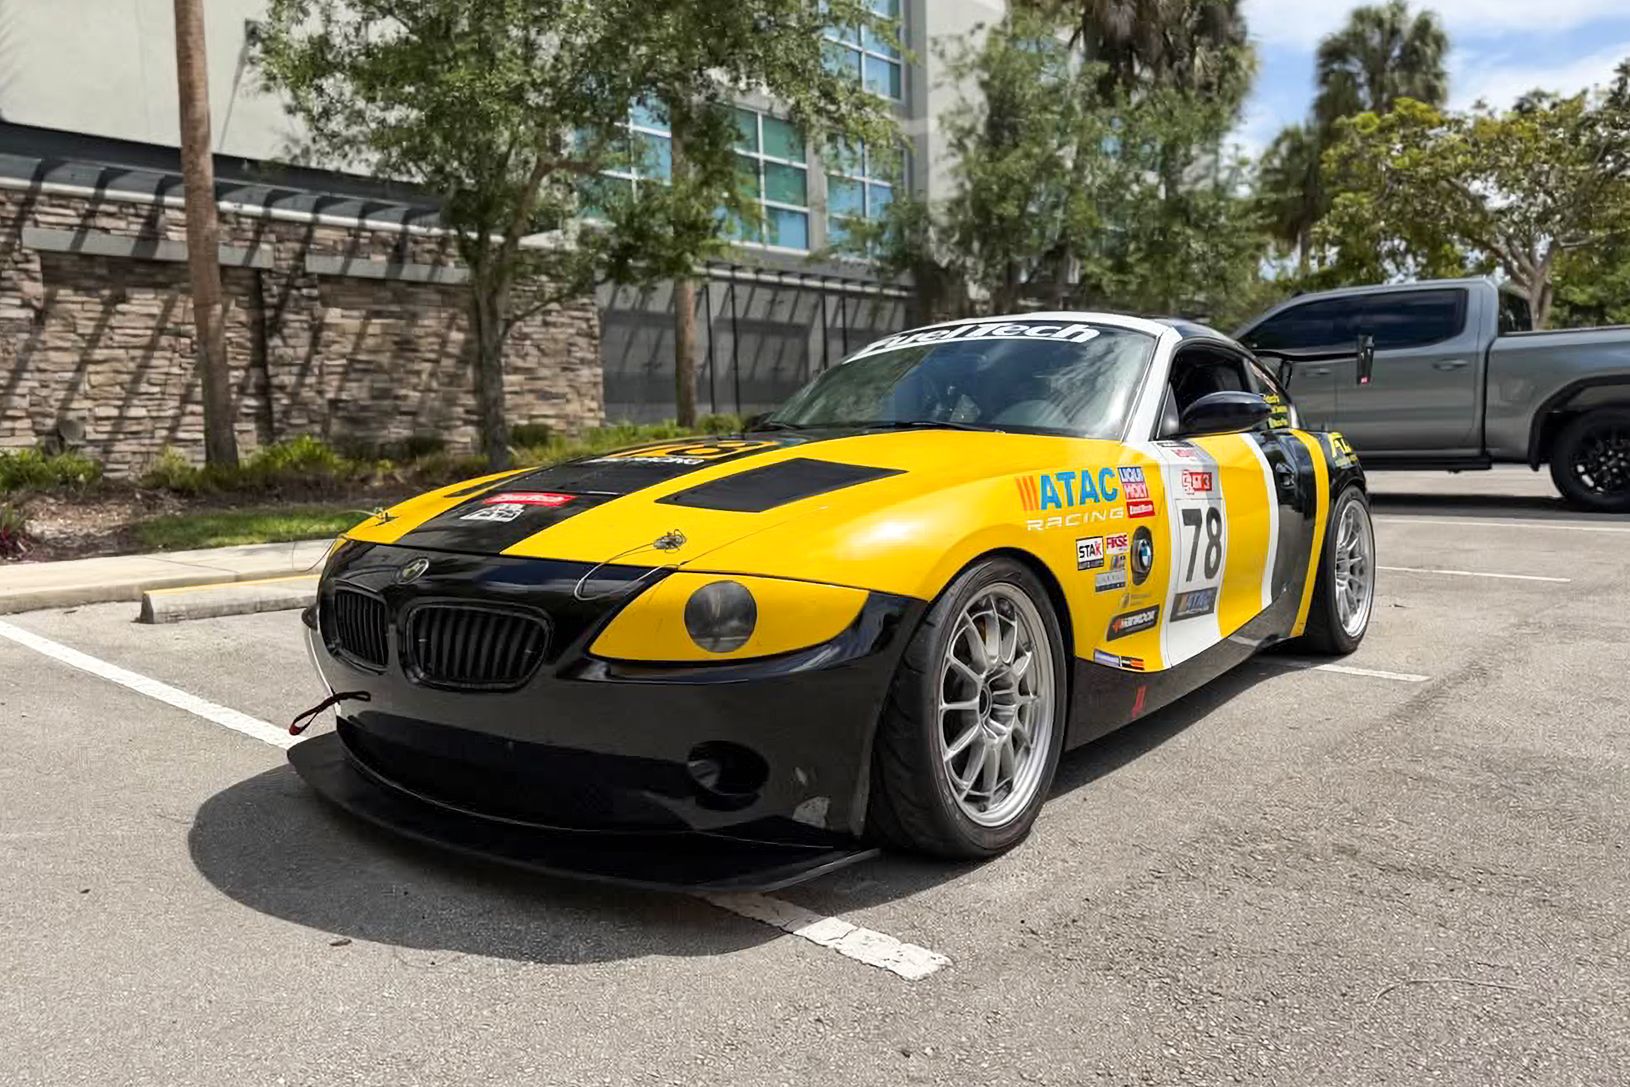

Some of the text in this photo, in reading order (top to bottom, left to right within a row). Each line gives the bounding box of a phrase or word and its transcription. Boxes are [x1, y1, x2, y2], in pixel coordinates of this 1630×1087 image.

[1040, 467, 1120, 511] ATAC
[1026, 506, 1125, 532] RACING
[1079, 541, 1102, 559] STAK
[1182, 506, 1223, 583] 78
